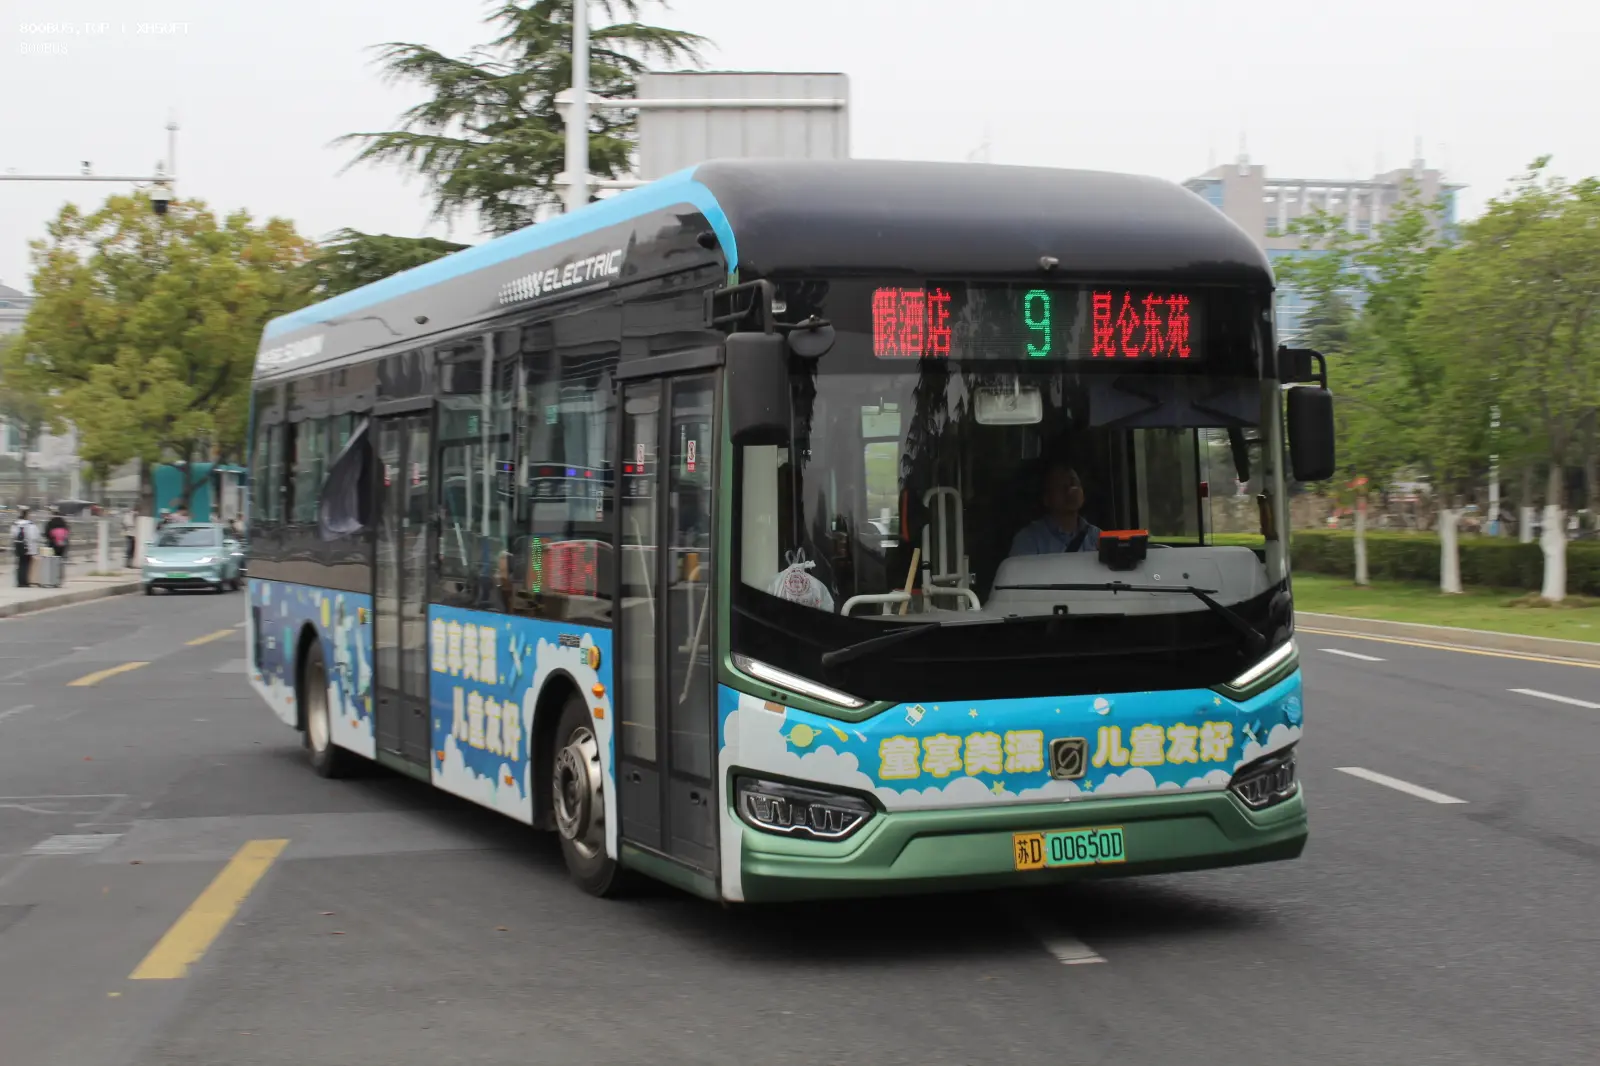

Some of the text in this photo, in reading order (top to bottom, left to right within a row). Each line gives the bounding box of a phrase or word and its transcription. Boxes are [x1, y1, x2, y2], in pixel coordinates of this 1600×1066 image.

[542, 249, 622, 292] ELECTRIC
[1024, 288, 1051, 357] 9
[1091, 290, 1192, 358] 昆仑东苑
[878, 730, 1044, 780] 童享美溧
[1092, 721, 1234, 768] 儿童友好
